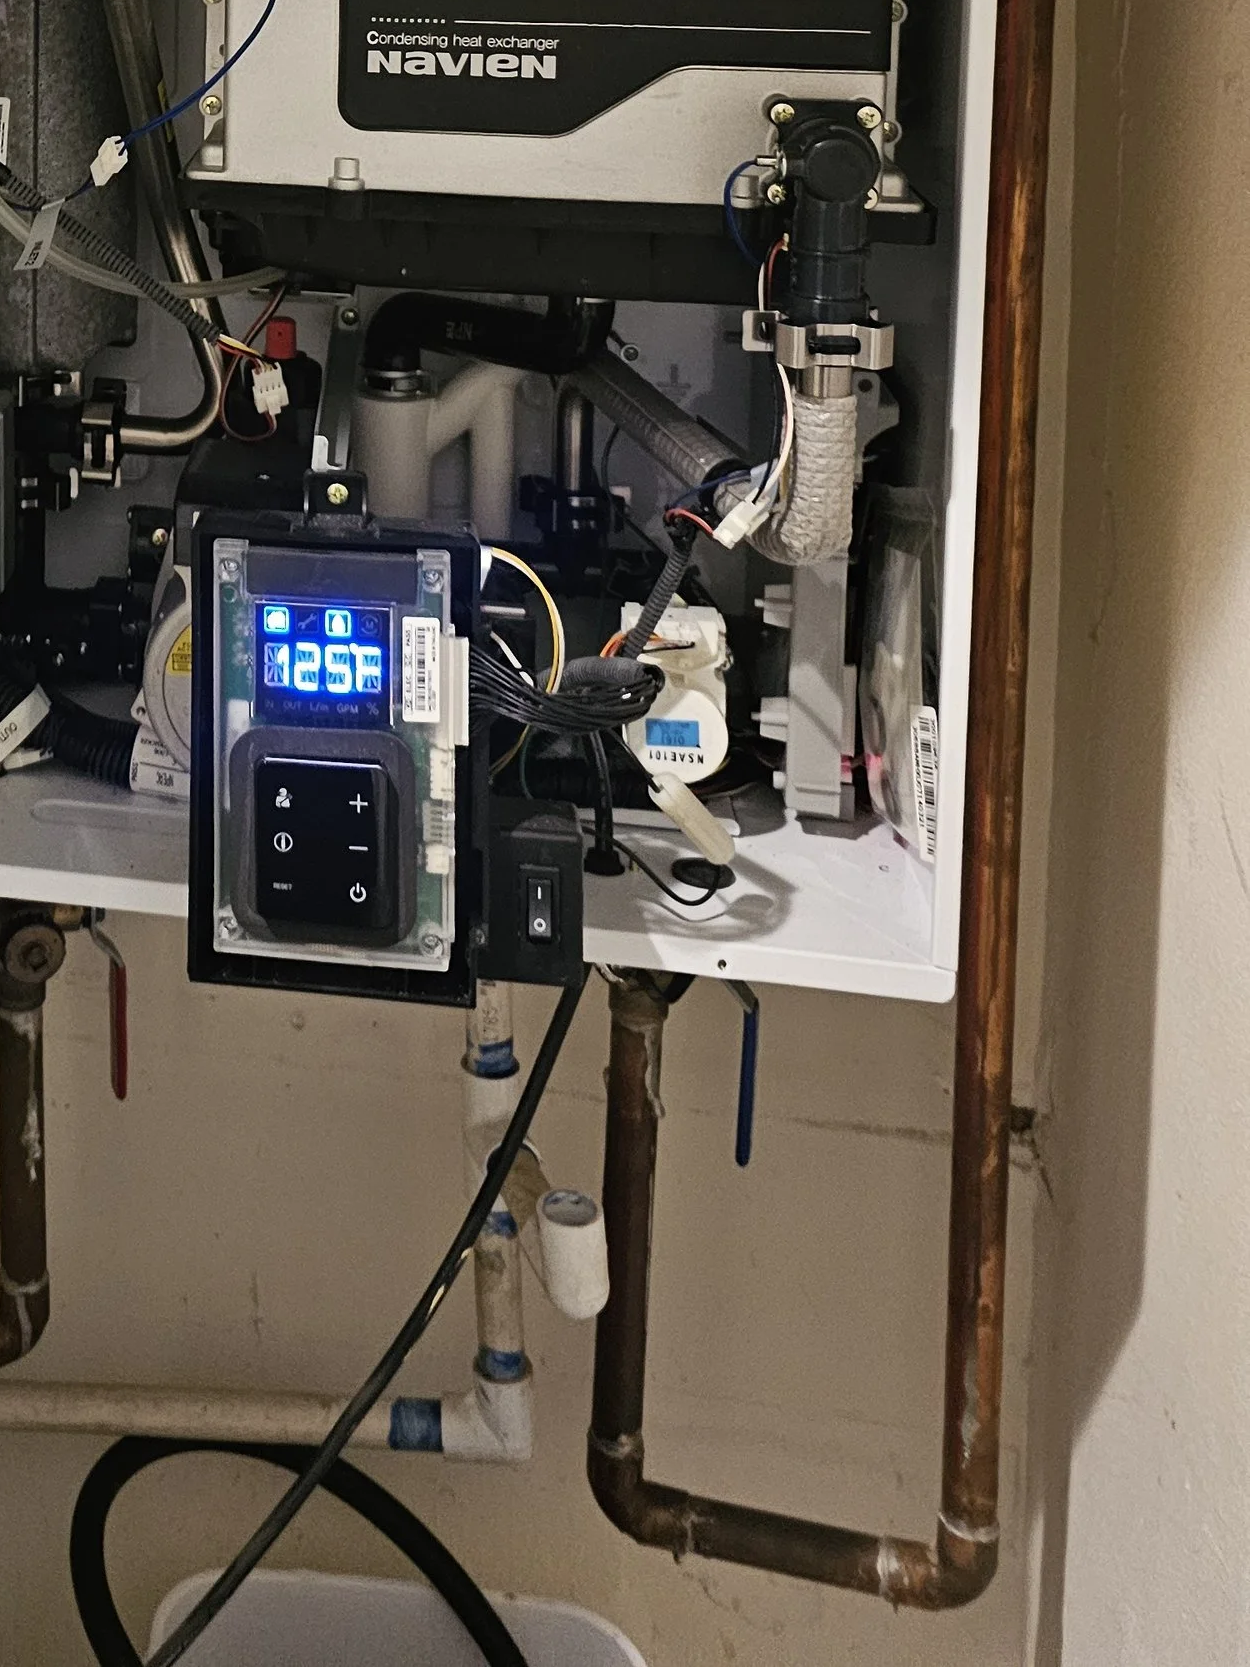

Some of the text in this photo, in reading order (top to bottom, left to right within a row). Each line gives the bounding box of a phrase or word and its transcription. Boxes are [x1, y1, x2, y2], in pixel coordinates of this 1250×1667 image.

[366, 30, 560, 51] Condensing heat exchanger
[336, 702, 359, 714] GPM
[365, 701, 380, 716] %
[649, 749, 704, 765] NSAE101
